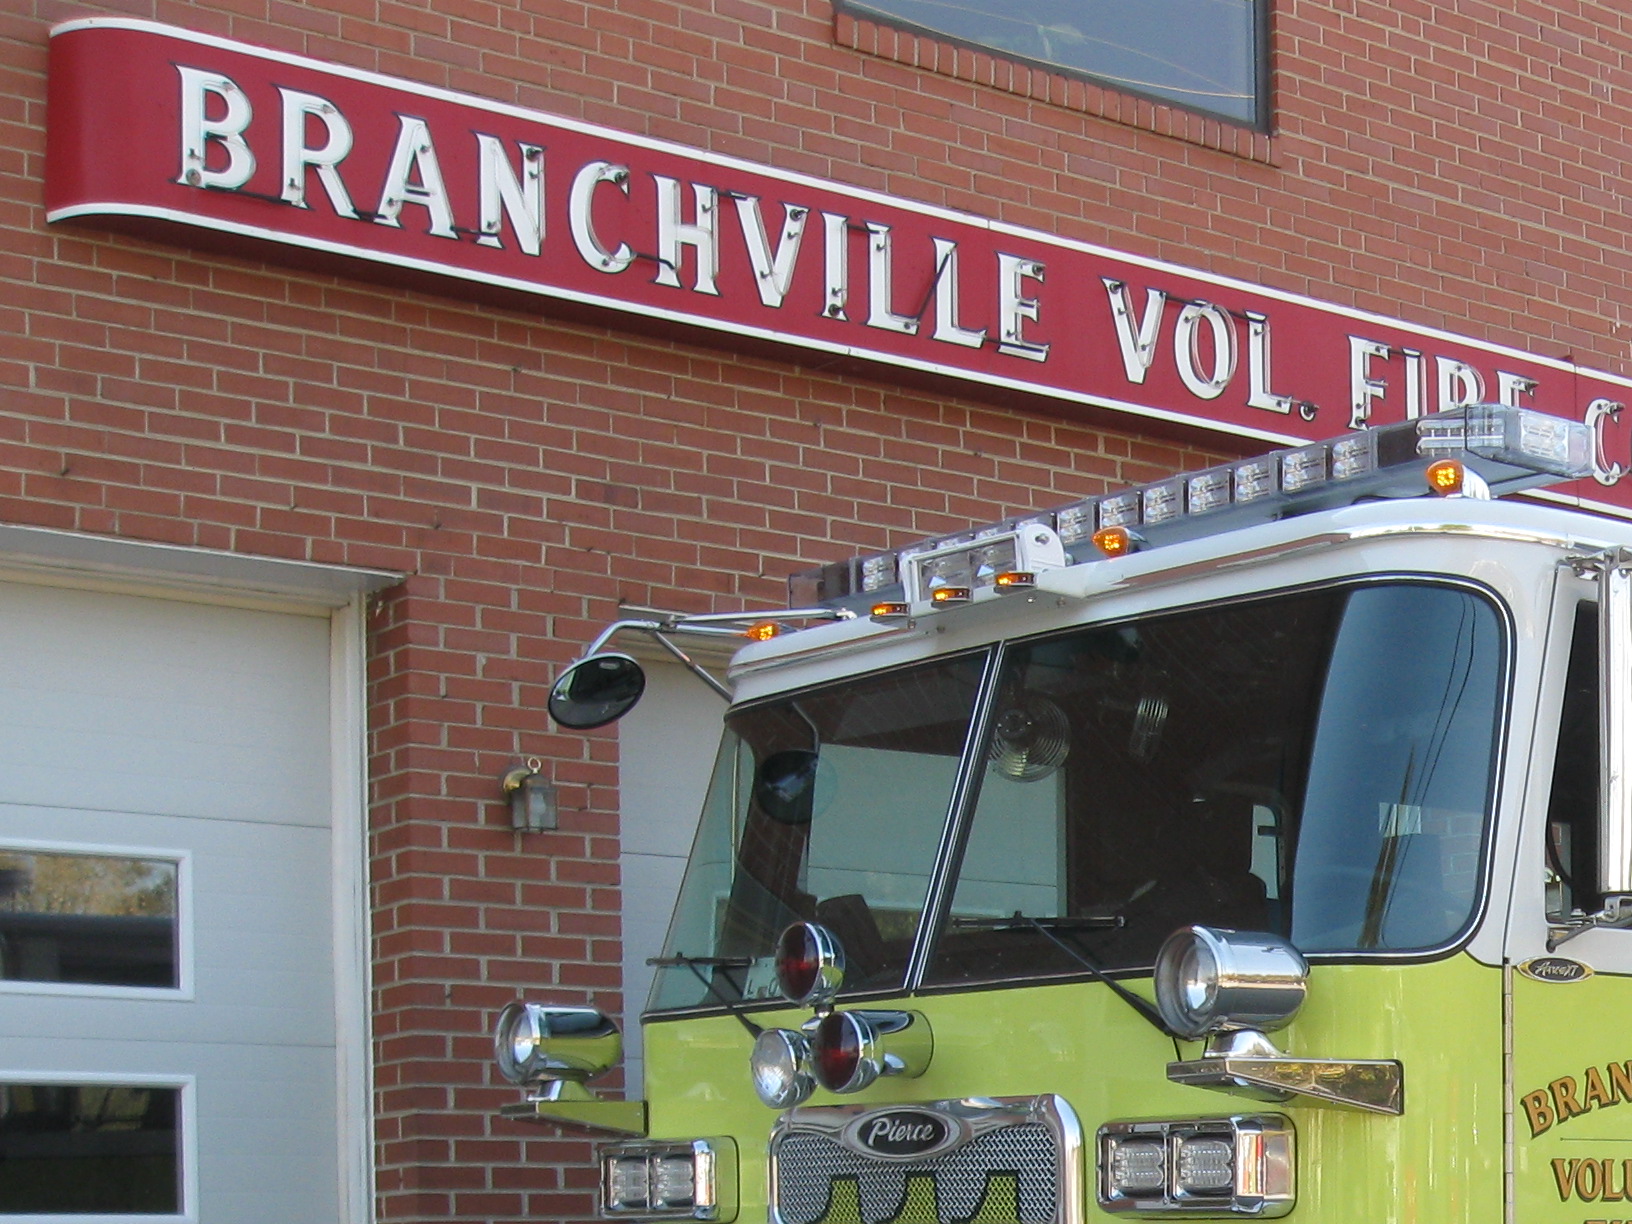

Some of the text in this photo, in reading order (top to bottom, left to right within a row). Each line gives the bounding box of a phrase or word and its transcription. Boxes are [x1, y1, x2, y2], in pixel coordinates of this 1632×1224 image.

[174, 62, 1051, 363] BRANCHVILLE
[1101, 276, 1319, 421] VOL.
[867, 1117, 935, 1147] Pierce
